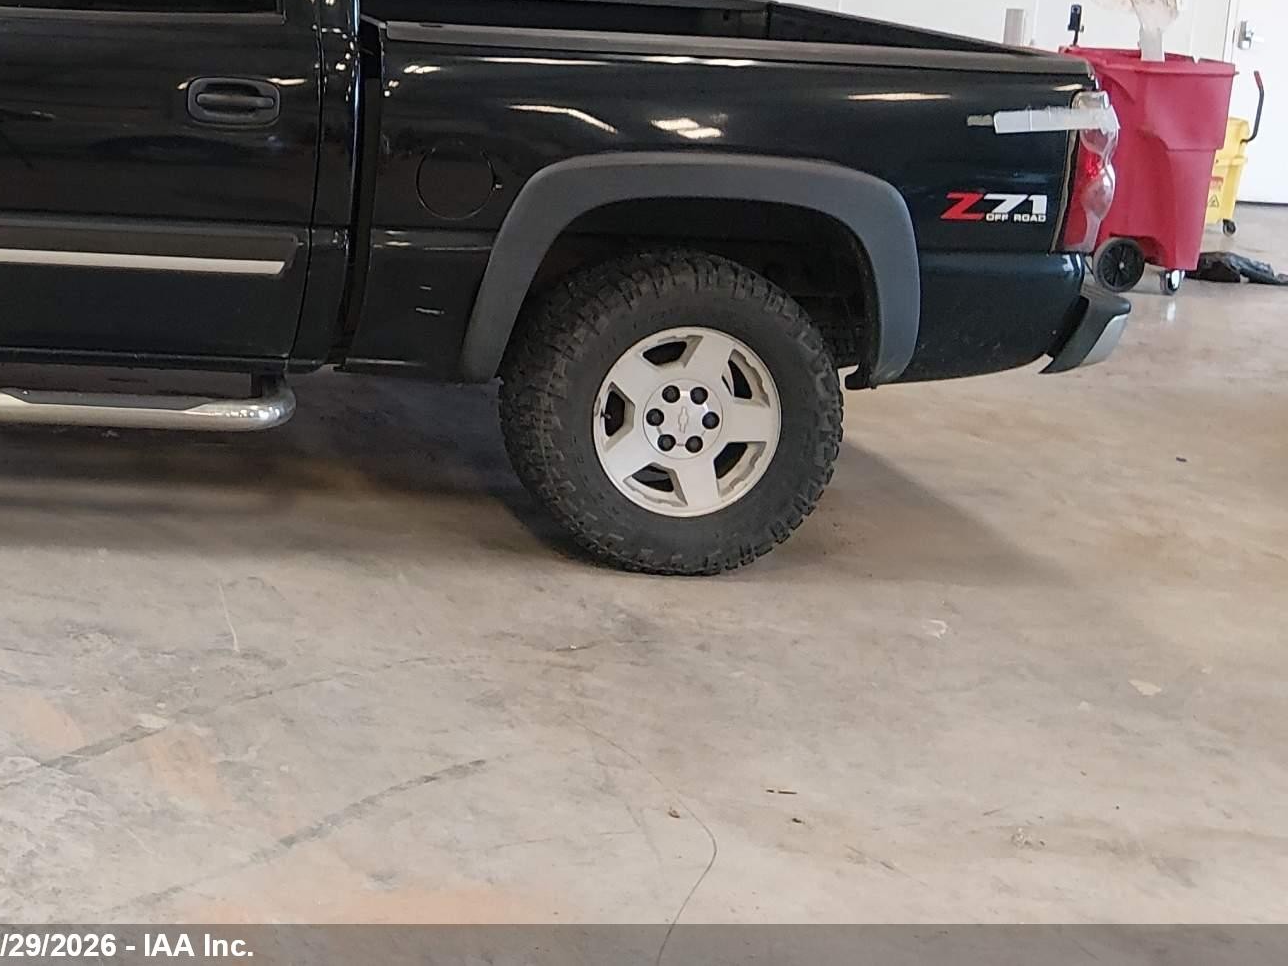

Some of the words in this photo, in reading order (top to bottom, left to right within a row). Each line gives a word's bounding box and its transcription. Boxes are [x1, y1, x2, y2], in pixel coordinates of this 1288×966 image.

[940, 192, 1047, 221] Z71
[986, 213, 1009, 222] OFF
[1014, 214, 1047, 223] ROAD
